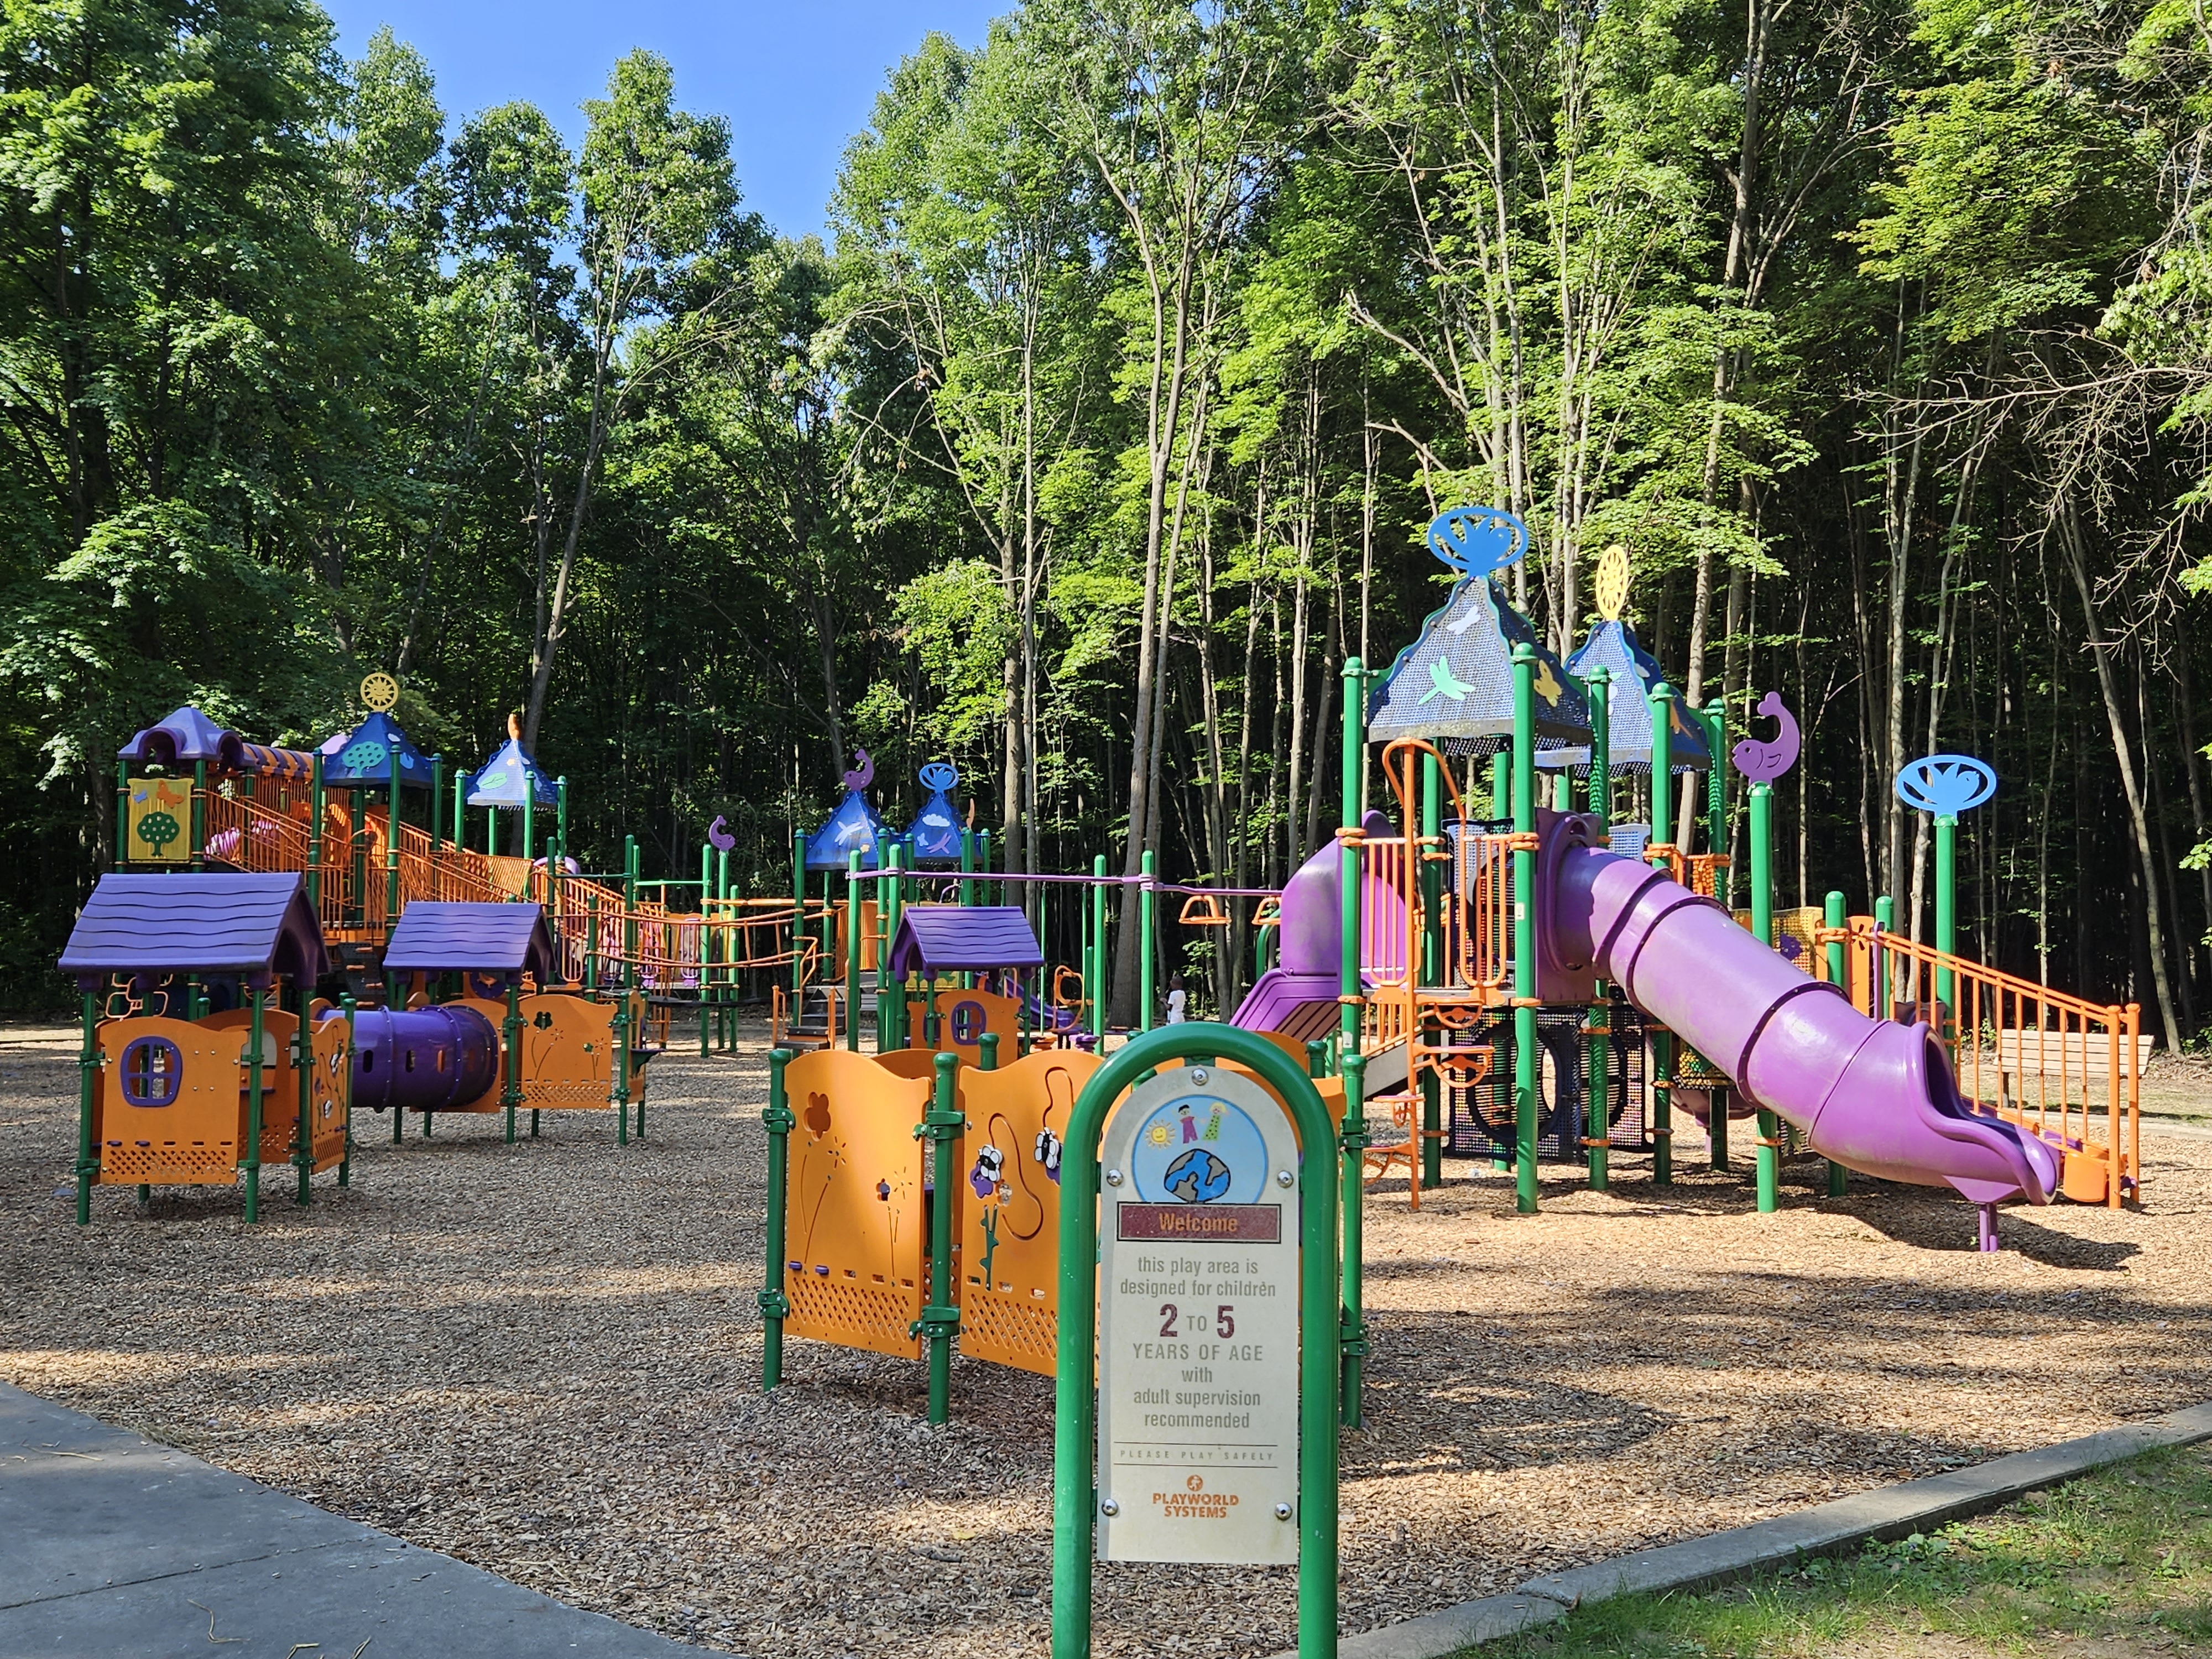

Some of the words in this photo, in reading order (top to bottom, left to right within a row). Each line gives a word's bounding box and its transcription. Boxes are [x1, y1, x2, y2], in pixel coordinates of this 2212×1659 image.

[1159, 1213, 1239, 1232] Welcome
[1138, 1257, 1164, 1272] this
[1171, 1258, 1201, 1276] play
[1208, 1261, 1239, 1274] area
[1246, 1259, 1258, 1274] is
[1121, 1279, 1185, 1298] designed
[1192, 1281, 1212, 1296] for
[1217, 1281, 1276, 1297] children
[1160, 1304, 1177, 1337] 2
[1187, 1316, 1207, 1331] TO
[1217, 1305, 1234, 1338] 5
[1133, 1343, 1189, 1360] YEARS
[1199, 1344, 1220, 1360] OF
[1229, 1345, 1263, 1361] AGE
[1182, 1367, 1212, 1383] with
[1134, 1389, 1170, 1405] adult
[1175, 1391, 1260, 1408] supervision
[1145, 1412, 1249, 1428] recommended
[1153, 1493, 1239, 1506] PLAYWORLD
[1165, 1506, 1227, 1518] SYSTEMS
